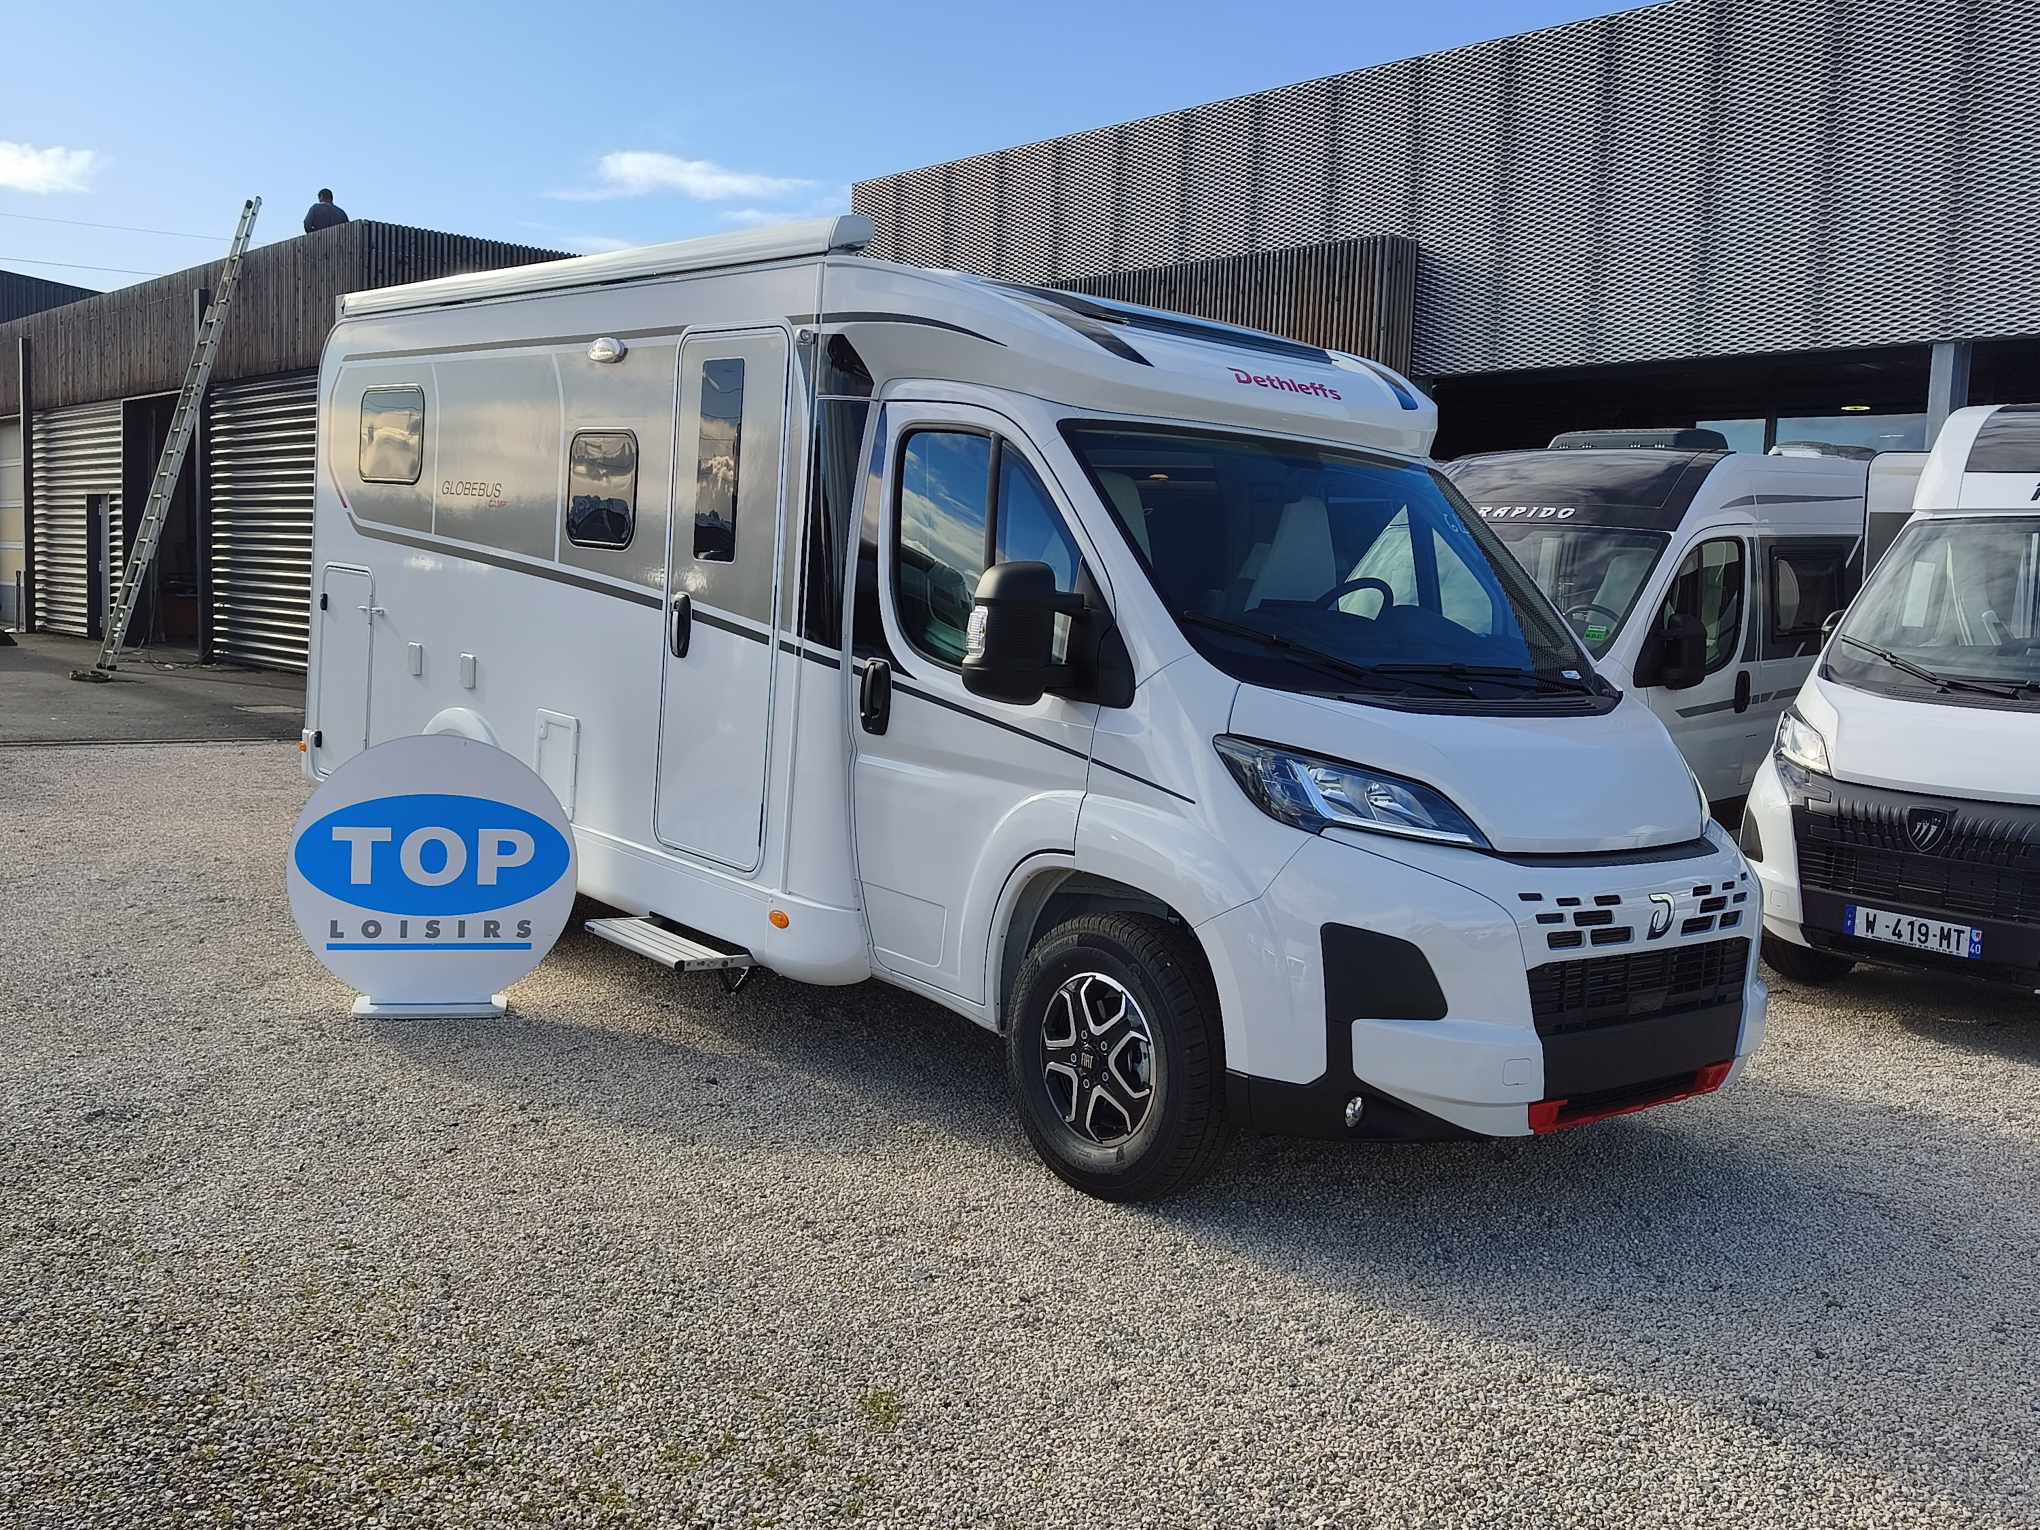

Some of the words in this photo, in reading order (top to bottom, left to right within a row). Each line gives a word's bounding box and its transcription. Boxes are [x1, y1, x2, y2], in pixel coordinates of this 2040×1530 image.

[1226, 367, 1341, 400] Dethleffs
[441, 480, 502, 498] GLOBEBUS
[1479, 506, 1575, 519] RAPIDO
[331, 826, 535, 887] TOP
[329, 919, 532, 939] LOISIRS
[1969, 943, 1982, 955] 40
